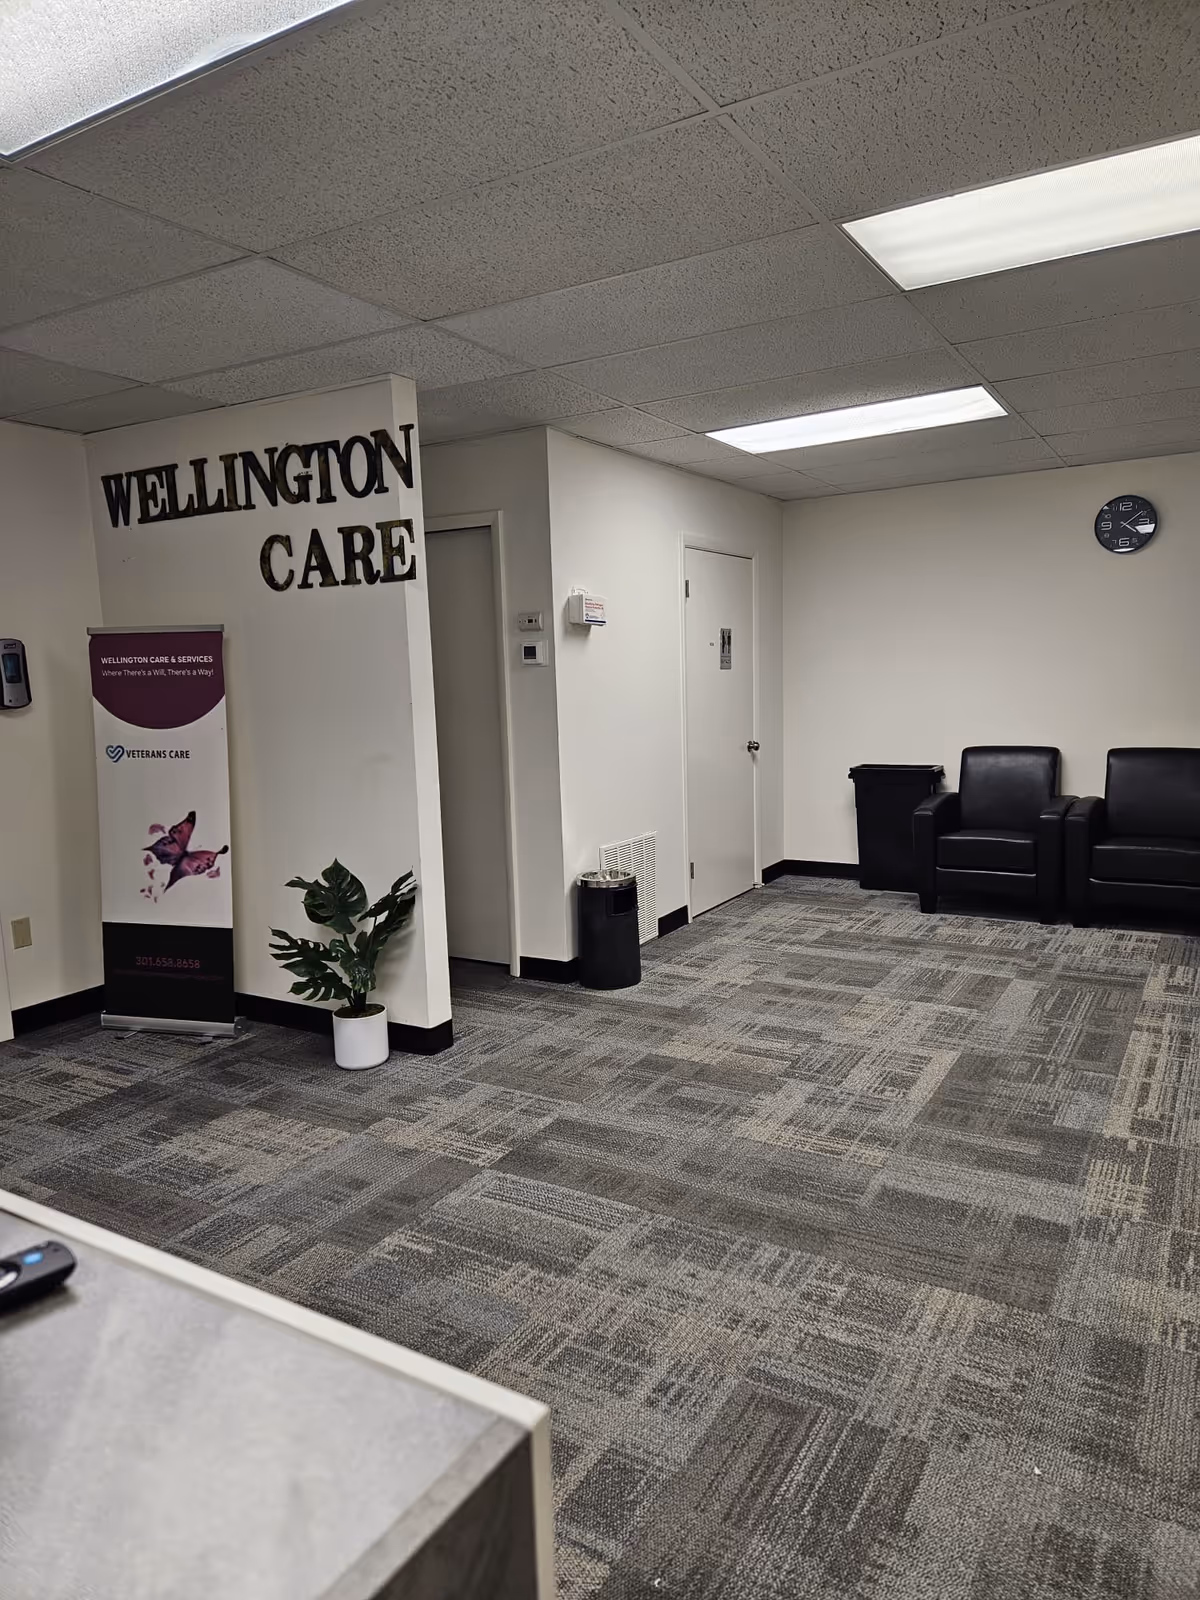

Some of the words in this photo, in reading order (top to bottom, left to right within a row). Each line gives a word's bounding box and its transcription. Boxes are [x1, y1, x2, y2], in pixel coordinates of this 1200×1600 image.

[101, 423, 415, 528] WELLINGTON
[1119, 502, 1132, 511] 12
[1101, 521, 1113, 531] 9
[1118, 537, 1130, 547] 6
[260, 518, 416, 592] CARE
[101, 656, 149, 664] WELLINGTON
[149, 656, 169, 664] CARE
[170, 655, 176, 663] &
[177, 655, 213, 663] SERVICES
[102, 669, 122, 677] Where
[167, 668, 191, 676] There's
[197, 668, 214, 677] Way!
[126, 750, 167, 759] VETERANS
[169, 750, 190, 759] CARE
